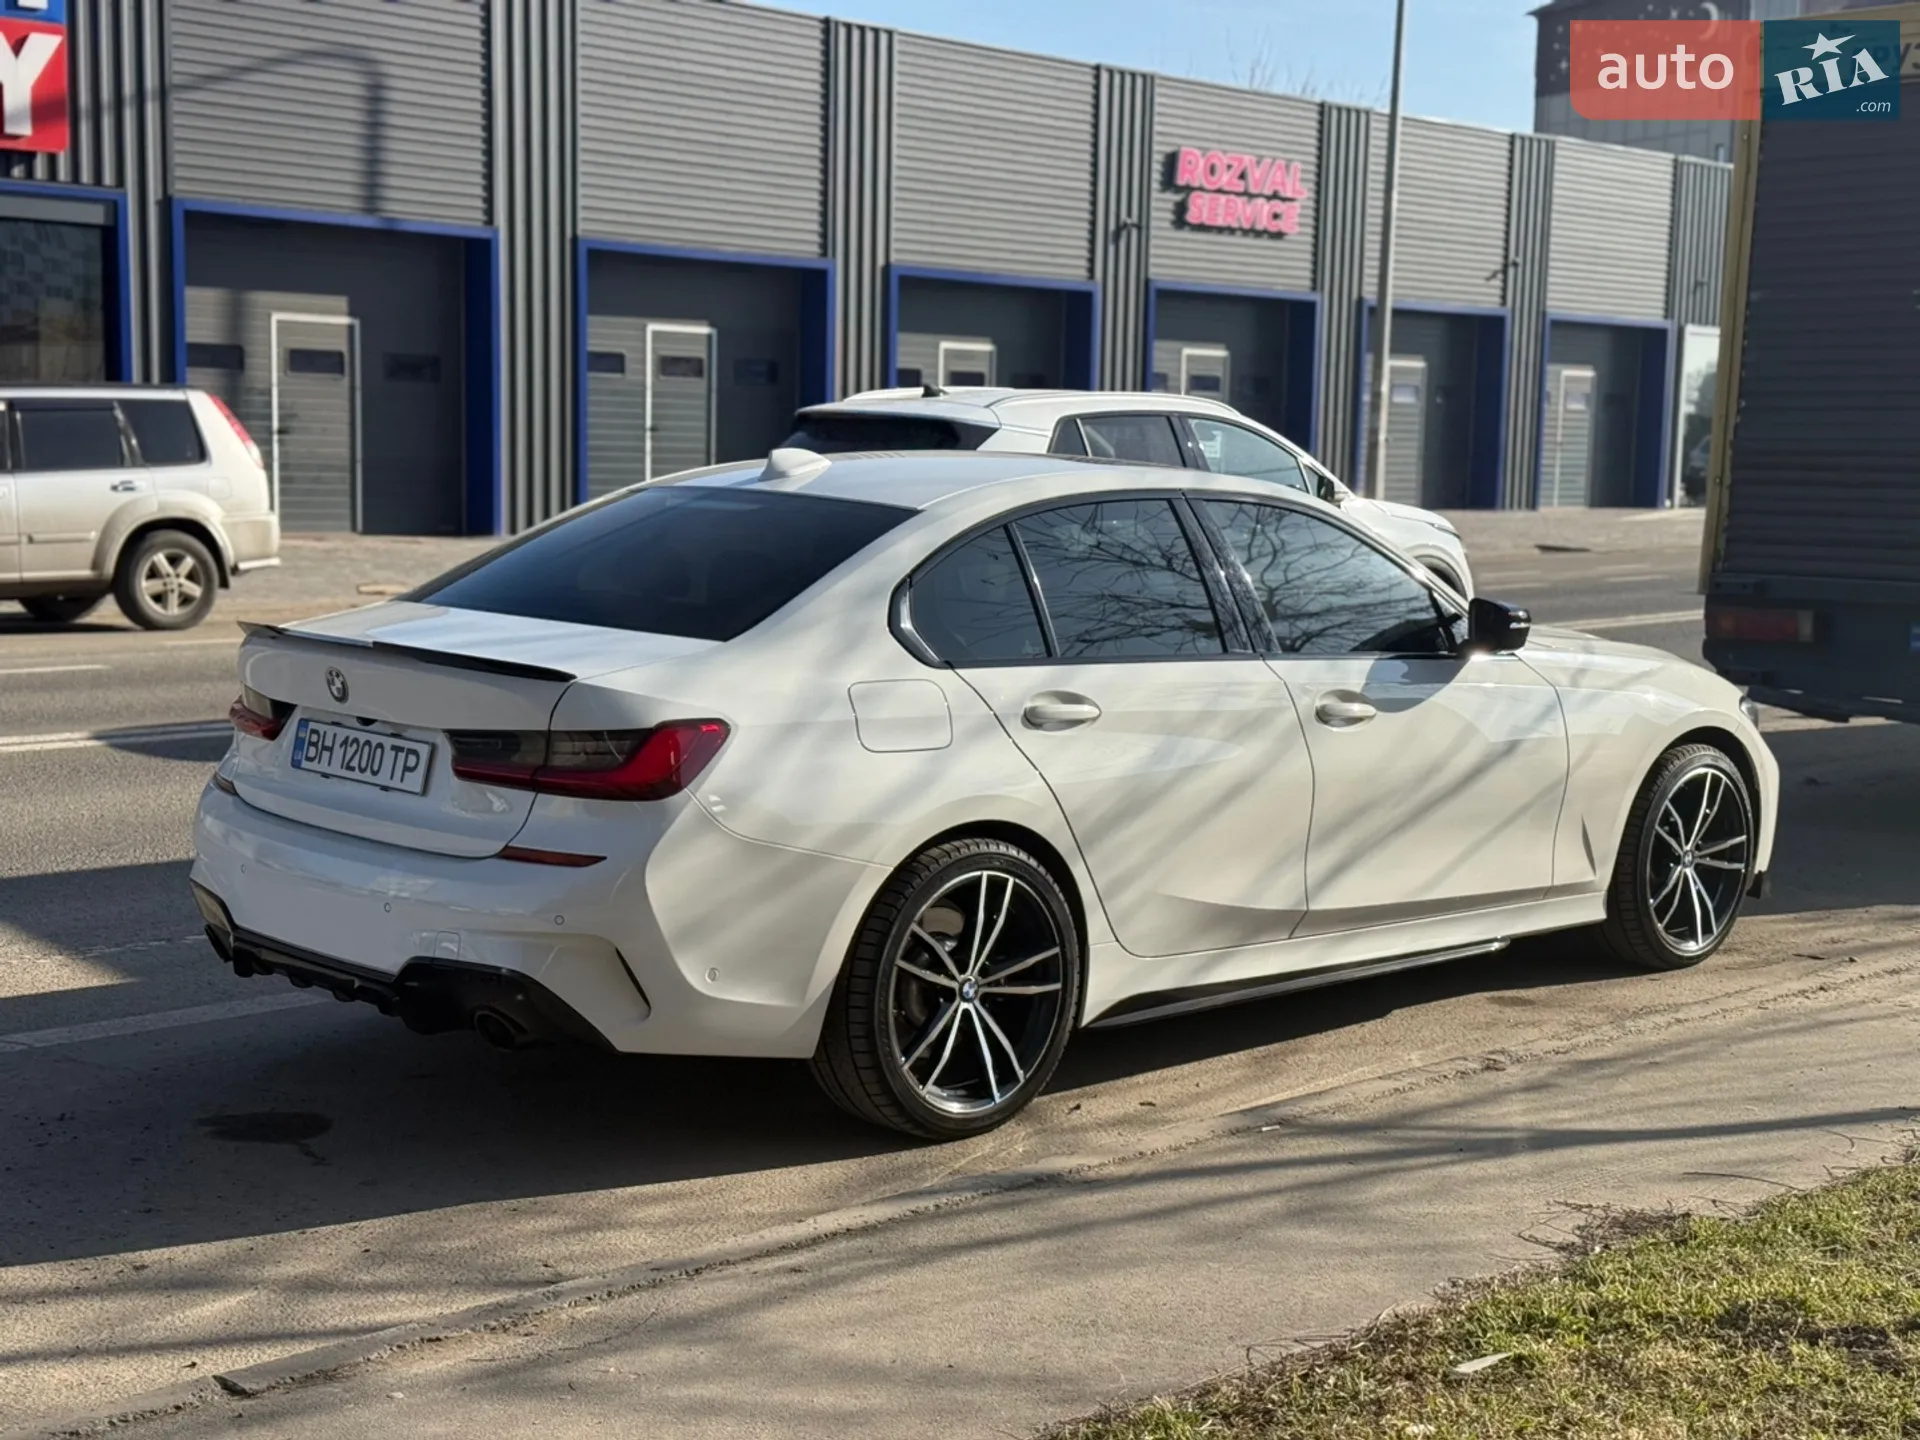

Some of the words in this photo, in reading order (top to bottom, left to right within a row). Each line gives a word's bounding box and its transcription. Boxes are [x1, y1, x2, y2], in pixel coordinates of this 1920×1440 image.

[1175, 146, 1308, 199] ROZVAL
[1186, 191, 1301, 234] SERVICE
[304, 728, 337, 767] BH
[339, 735, 385, 777] 1200
[389, 744, 421, 783] TP
